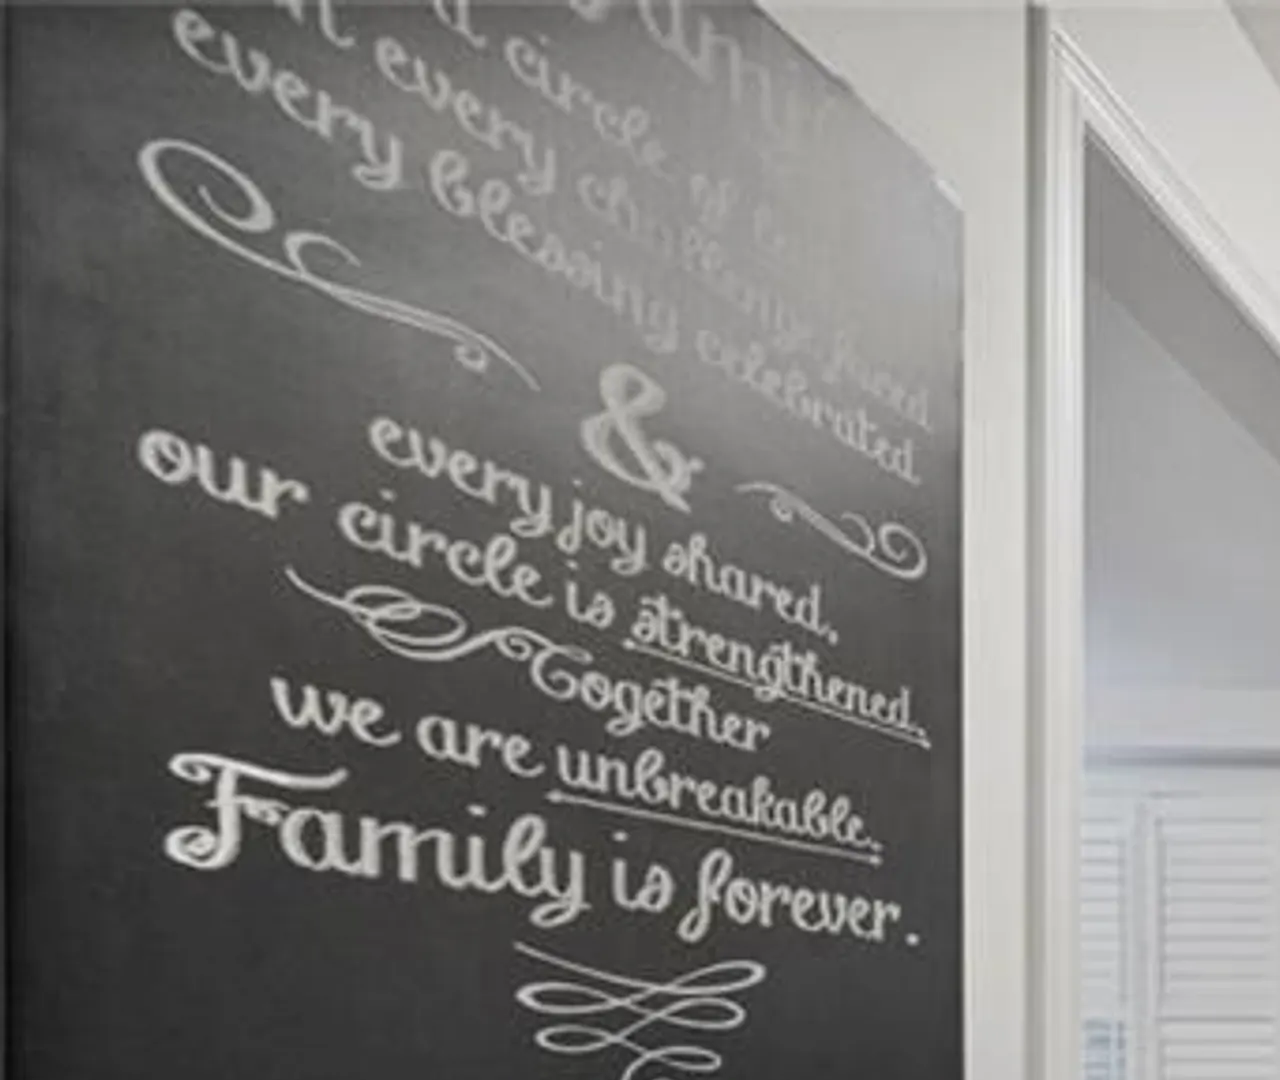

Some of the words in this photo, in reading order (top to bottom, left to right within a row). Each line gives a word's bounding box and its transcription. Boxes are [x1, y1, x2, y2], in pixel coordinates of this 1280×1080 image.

[173, 10, 402, 190] every
[431, 151, 680, 354] blessing
[375, 36, 557, 195] every
[368, 416, 556, 537] every
[556, 480, 648, 576] joy
[582, 363, 705, 513] &
[138, 428, 310, 519] our
[337, 491, 554, 607] circle
[563, 560, 616, 629] is
[270, 677, 400, 746] we
[416, 714, 546, 777] are
[530, 640, 771, 752] Together
[164, 751, 592, 929] Family
[609, 829, 676, 913] is
[677, 848, 920, 945] forever.
